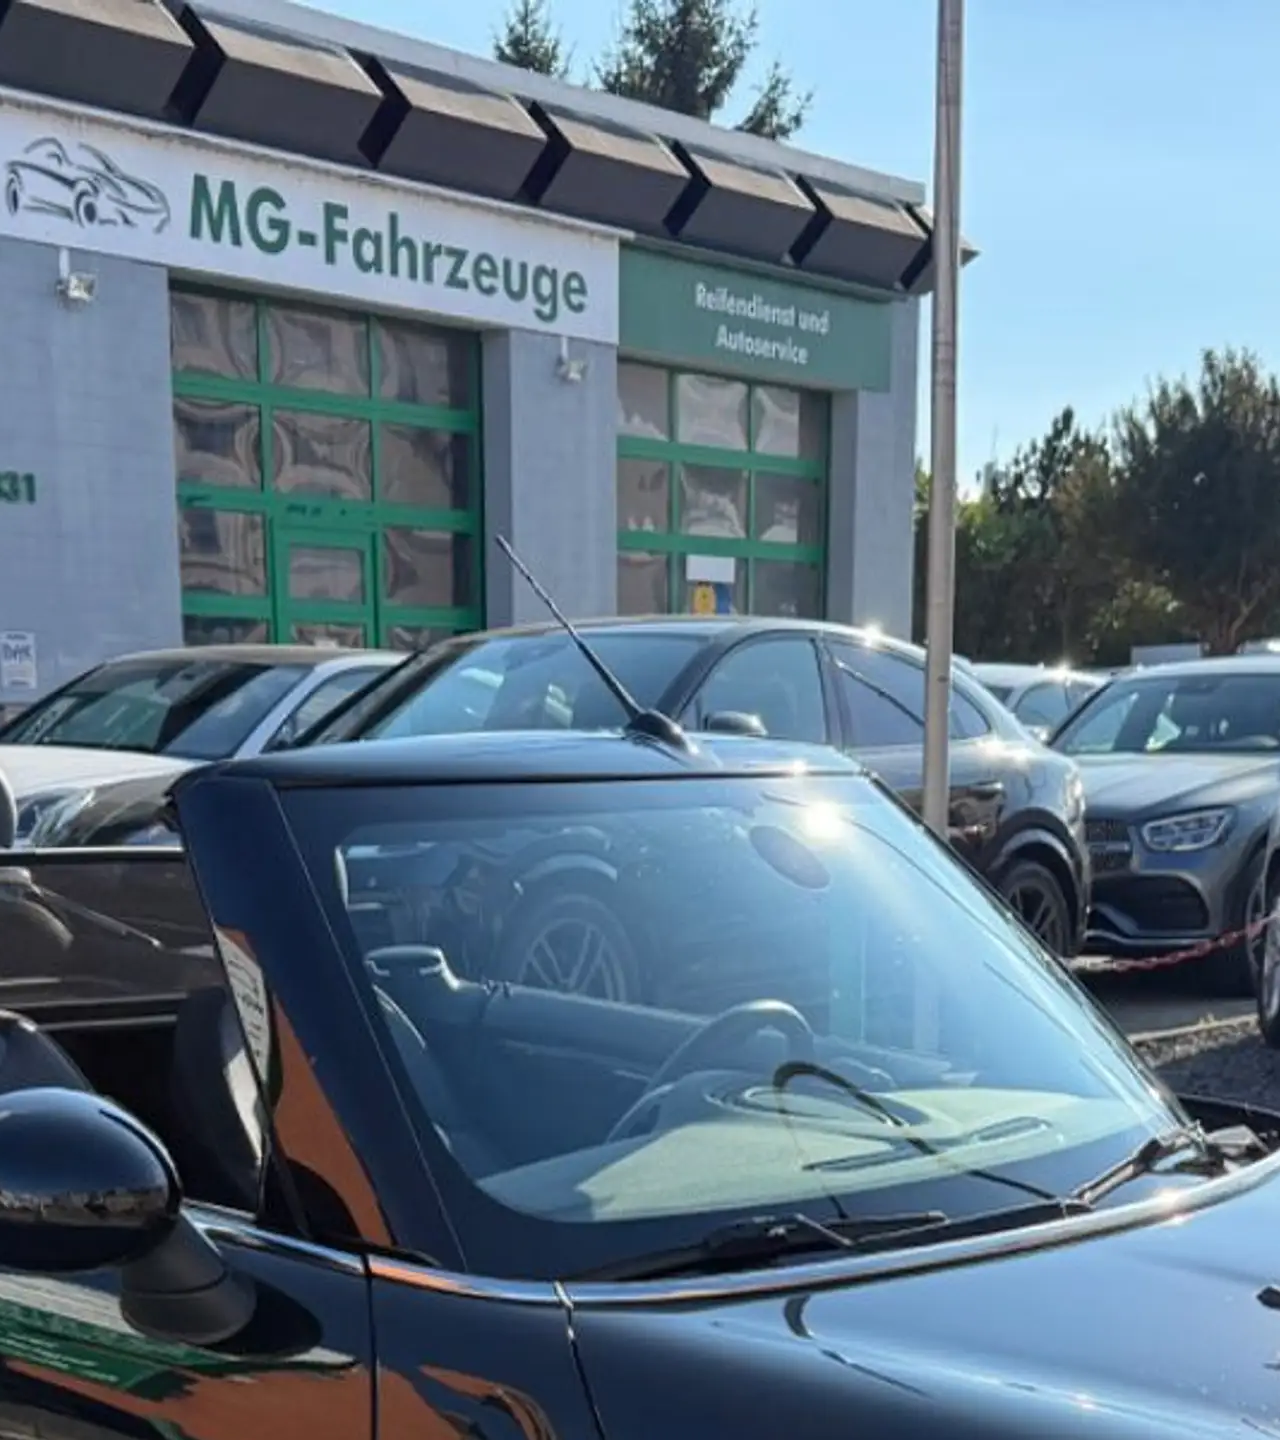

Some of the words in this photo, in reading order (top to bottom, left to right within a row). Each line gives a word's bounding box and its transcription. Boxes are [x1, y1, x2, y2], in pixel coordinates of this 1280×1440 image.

[190, 174, 588, 322] MG-Fahrzeuge
[695, 282, 795, 328] Reifendienst
[799, 310, 829, 335] und
[716, 324, 808, 365] Autoservice
